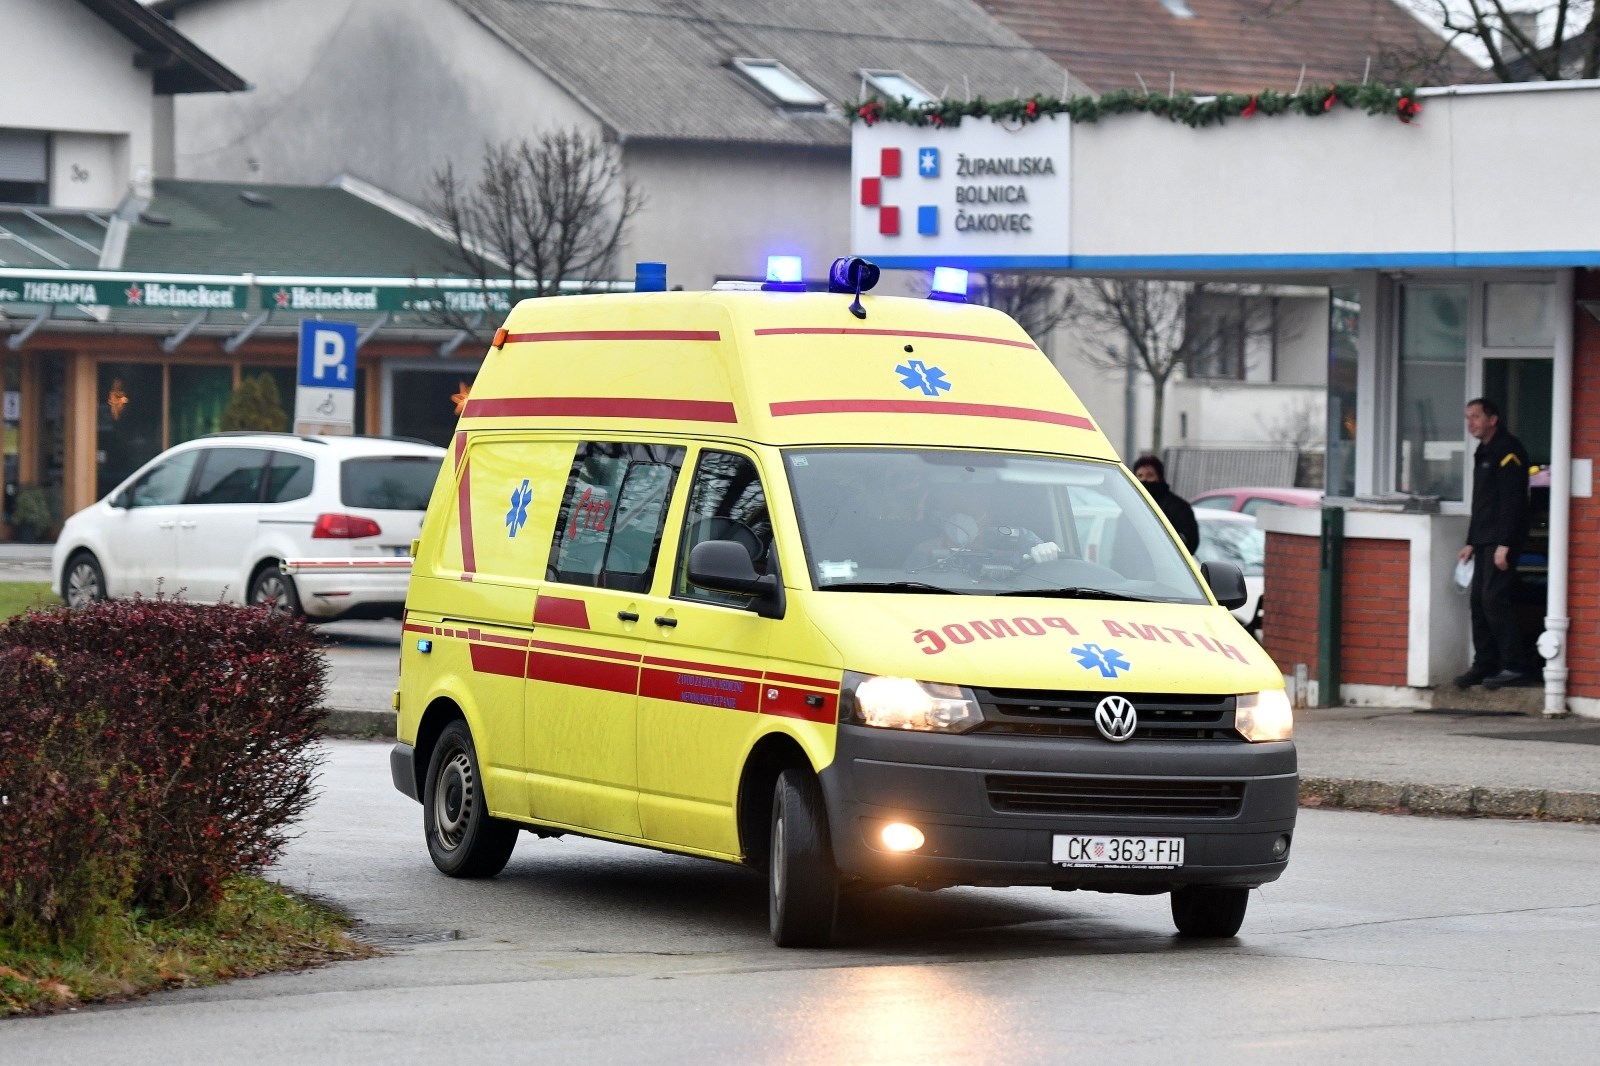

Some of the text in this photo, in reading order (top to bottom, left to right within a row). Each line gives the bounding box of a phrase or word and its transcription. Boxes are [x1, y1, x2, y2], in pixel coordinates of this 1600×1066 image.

[956, 153, 1055, 175] ŽUPANIJSKA
[956, 185, 1028, 203] BOLNICA
[955, 209, 1032, 231] ČAKOVEC
[23, 281, 97, 303] THERAPIA
[144, 283, 236, 308] Heineken
[291, 286, 378, 310] Heineken
[313, 329, 345, 380] P
[584, 499, 611, 531] 112
[1109, 839, 1180, 862] 363-FH
